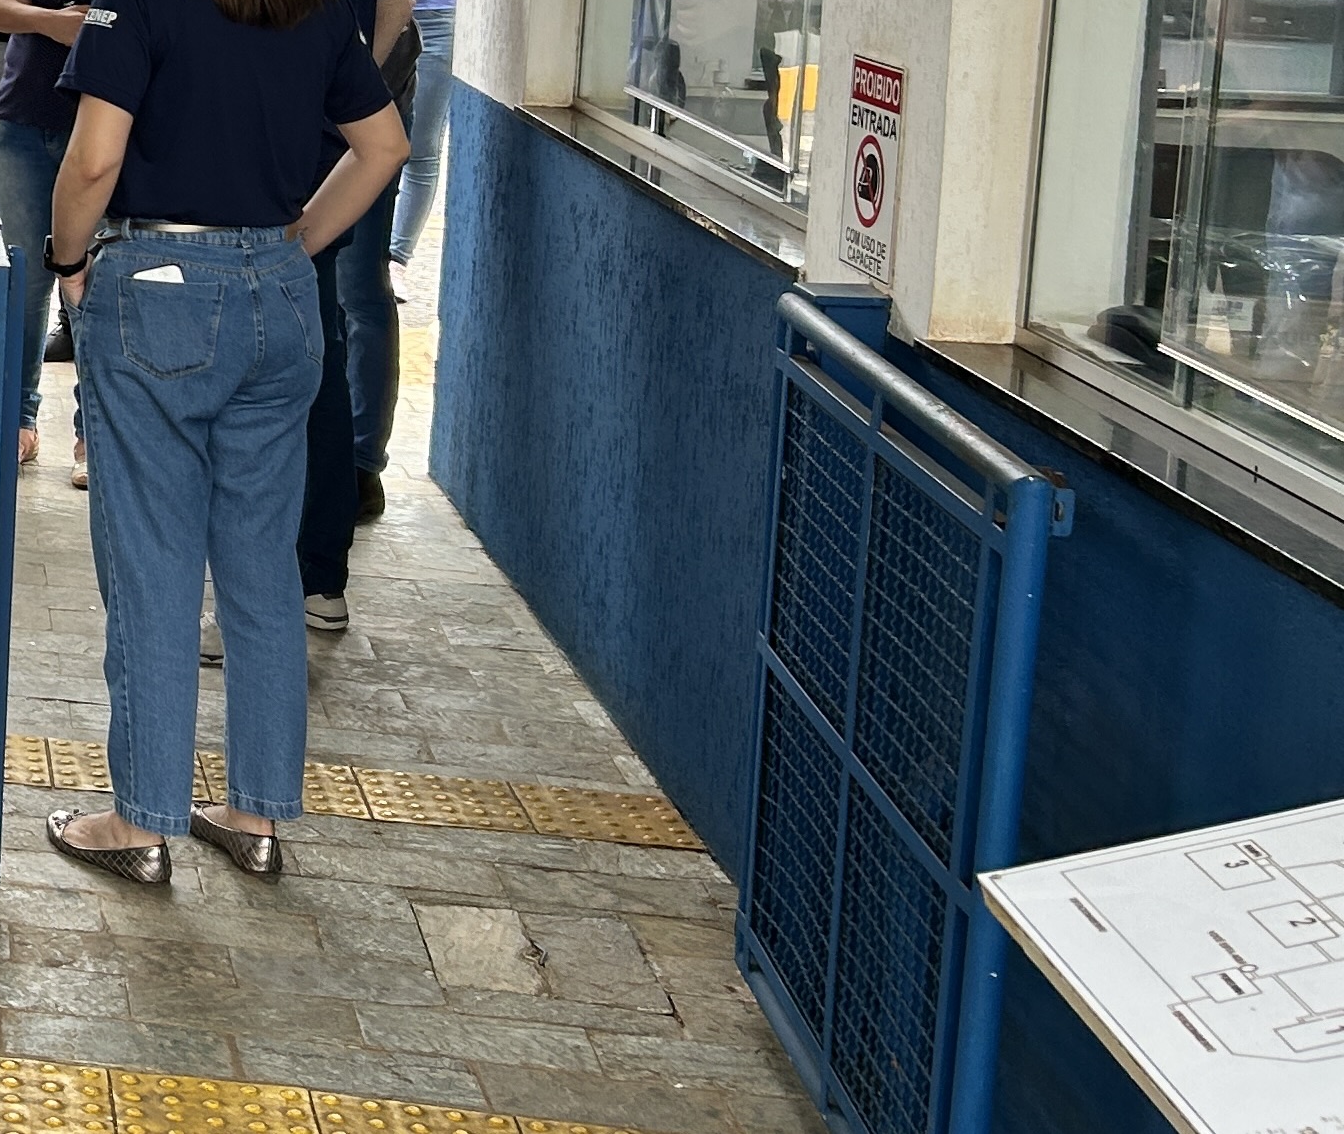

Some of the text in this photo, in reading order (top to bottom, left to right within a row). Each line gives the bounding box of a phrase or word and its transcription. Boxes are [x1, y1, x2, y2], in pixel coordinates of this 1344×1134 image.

[853, 66, 901, 106] PROIBIDO
[852, 103, 897, 142] ENTRADA
[845, 226, 887, 260] COM USO DE
[847, 244, 882, 277] CAPACETE
[1224, 859, 1250, 869] 3
[1288, 917, 1318, 927] 2
